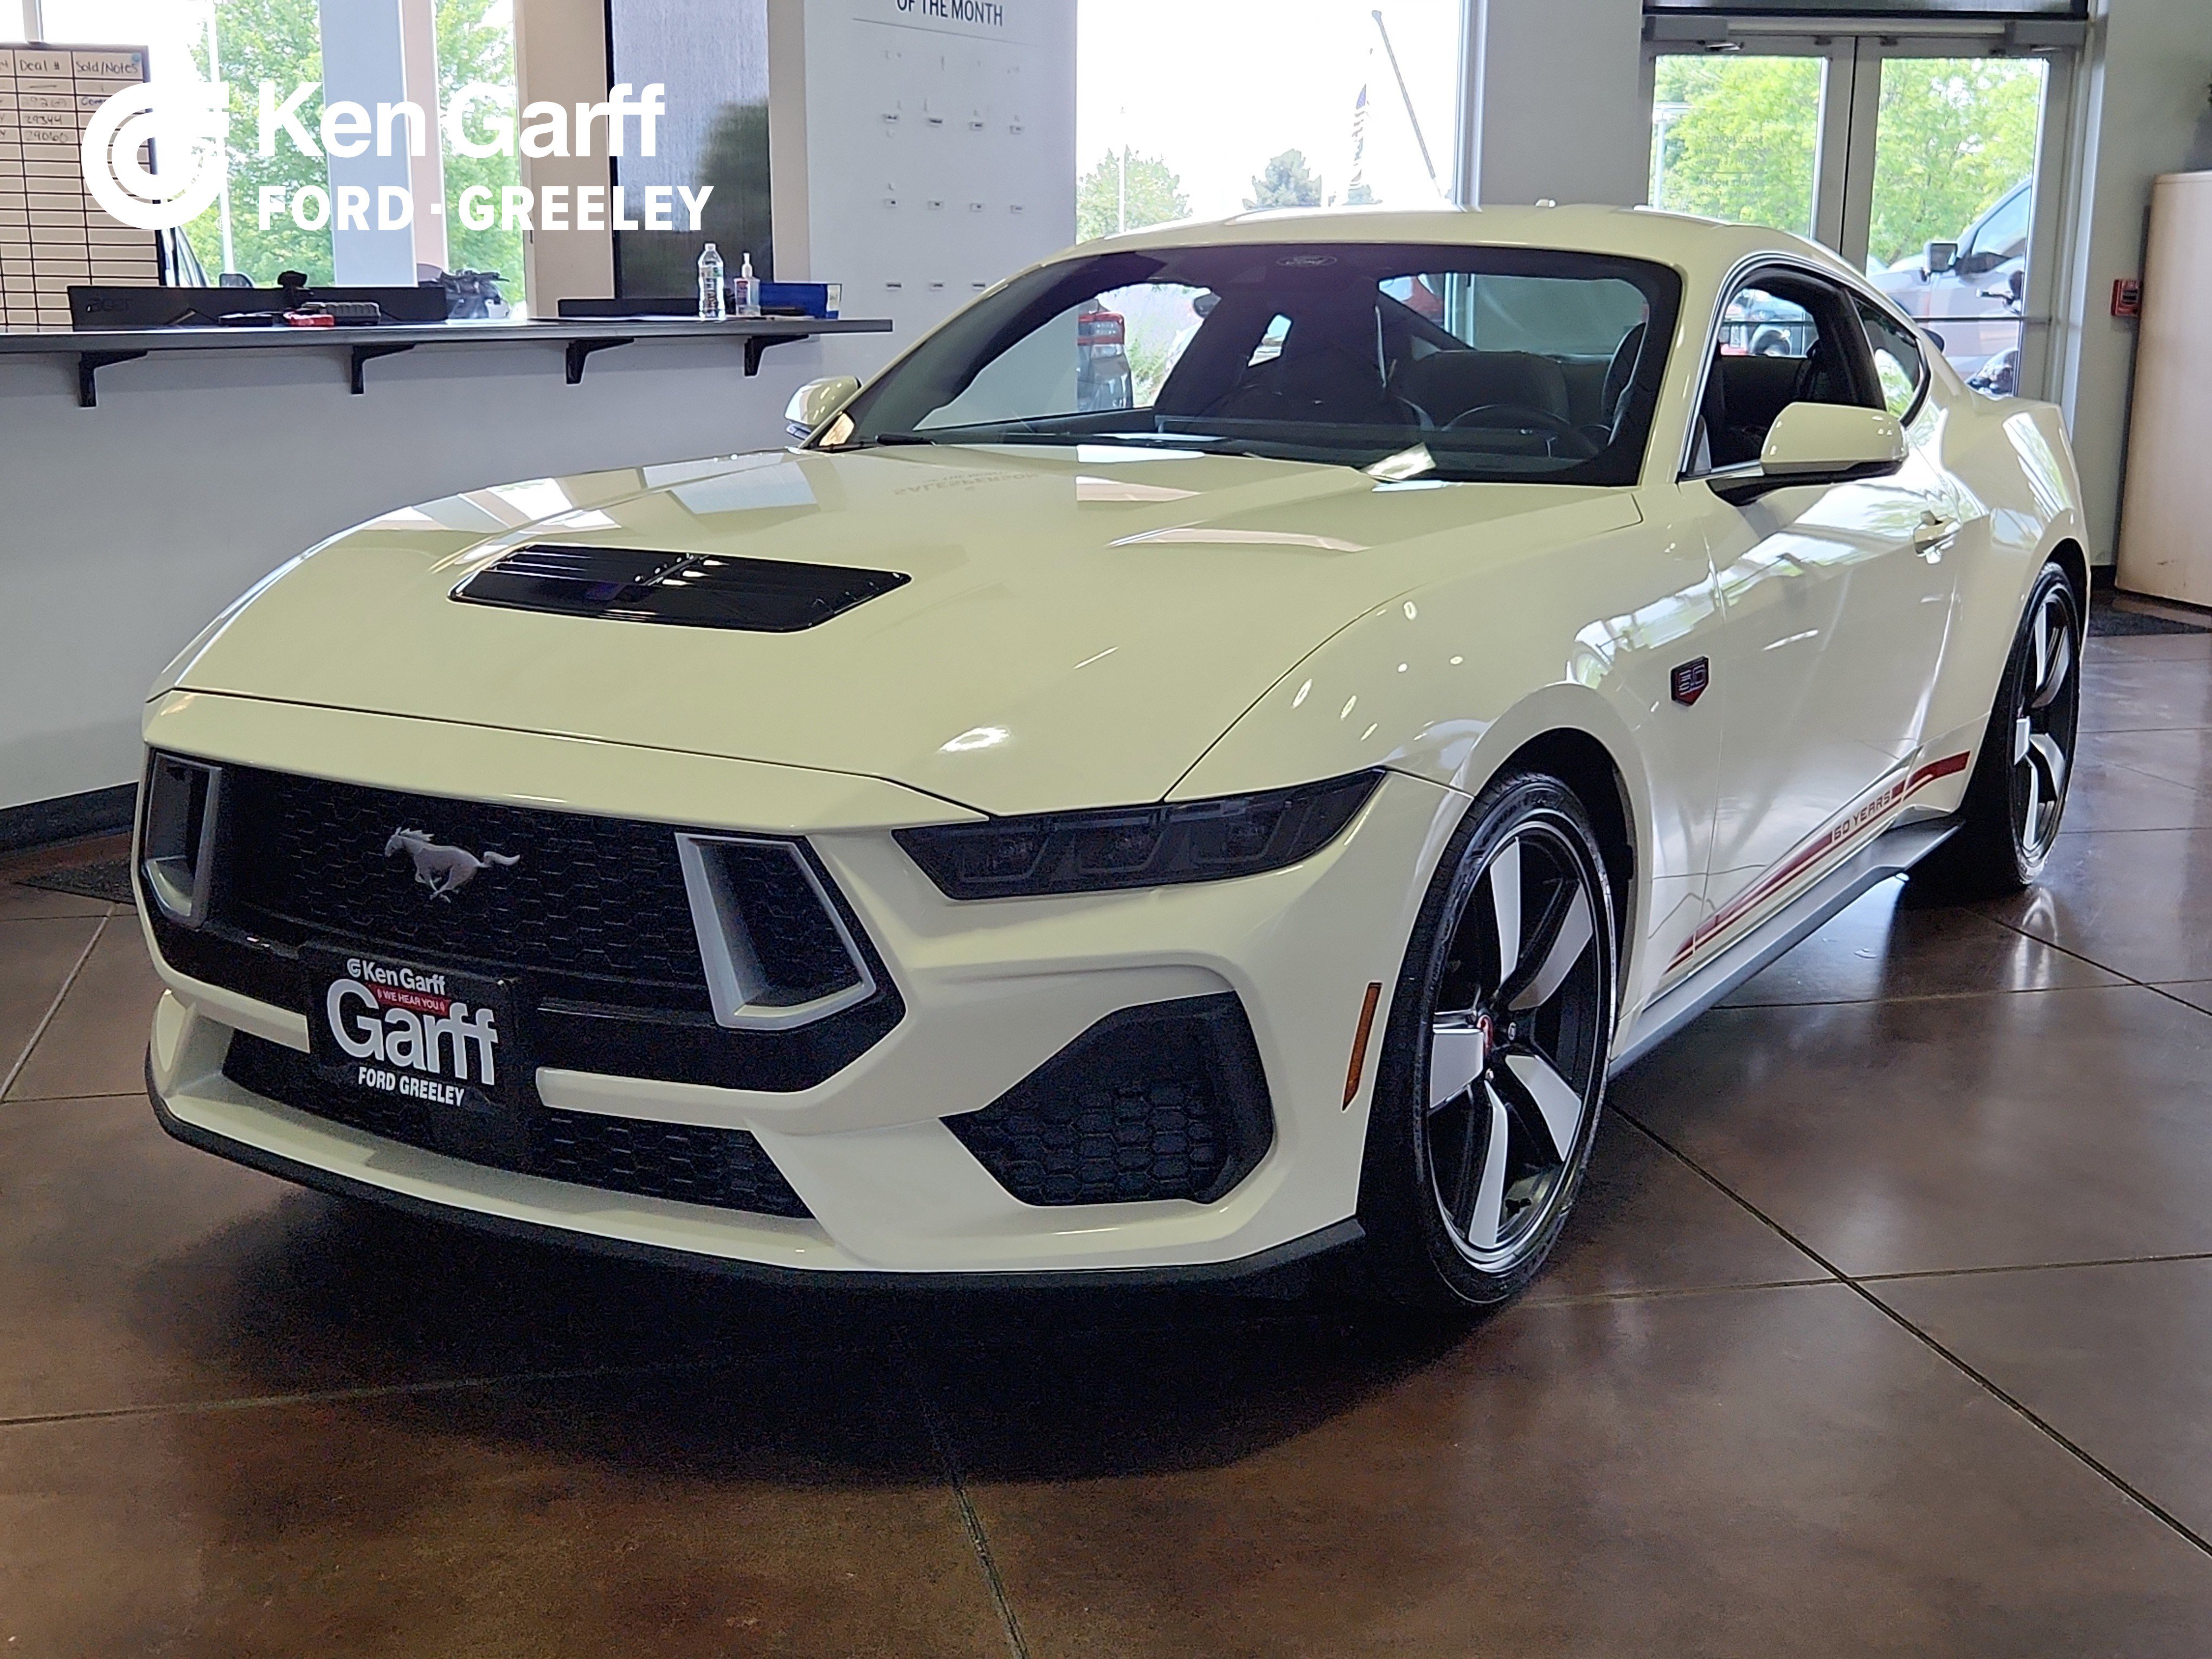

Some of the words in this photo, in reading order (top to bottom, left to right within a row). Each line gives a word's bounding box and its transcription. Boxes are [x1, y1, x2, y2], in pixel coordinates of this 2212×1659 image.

[922, 0, 948, 17] THE
[952, 0, 1002, 27] MONTH
[20, 60, 47, 71] Deal
[76, 61, 138, 74] Sold/Notes
[1853, 789, 1891, 826] YEARS
[362, 960, 398, 987] Ken
[400, 968, 445, 995] Garff
[382, 990, 397, 1001] WE
[398, 994, 421, 1005] HEAR
[422, 998, 440, 1011] YOU
[327, 979, 498, 1085] Garff
[358, 1066, 396, 1091] FORD
[399, 1075, 465, 1107] GREELEY
